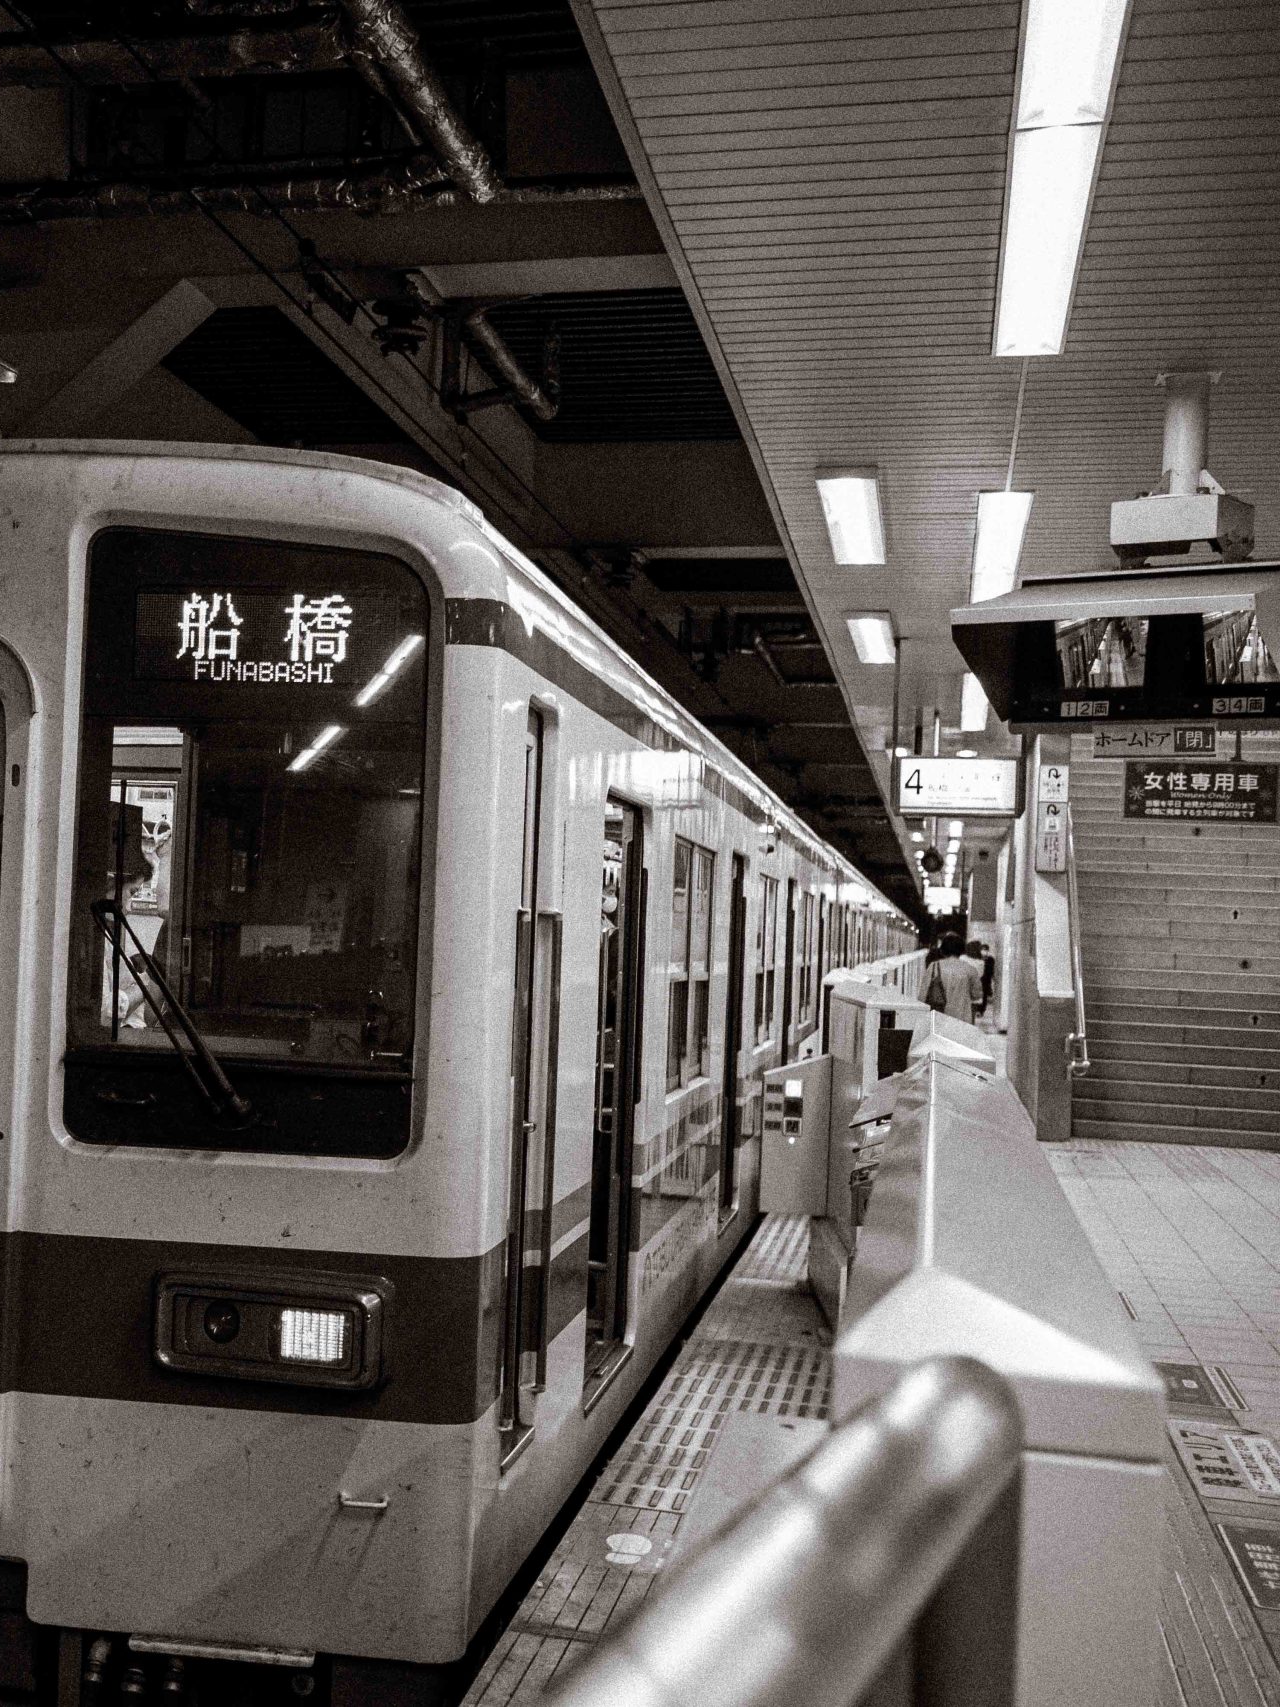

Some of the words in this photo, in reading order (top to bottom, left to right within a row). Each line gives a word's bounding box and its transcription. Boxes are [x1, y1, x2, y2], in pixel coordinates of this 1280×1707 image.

[177, 592, 353, 662] 船橋
[194, 660, 334, 684] FUNABASHI
[904, 768, 924, 795] 4
[1144, 771, 1259, 792] 女性専用車
